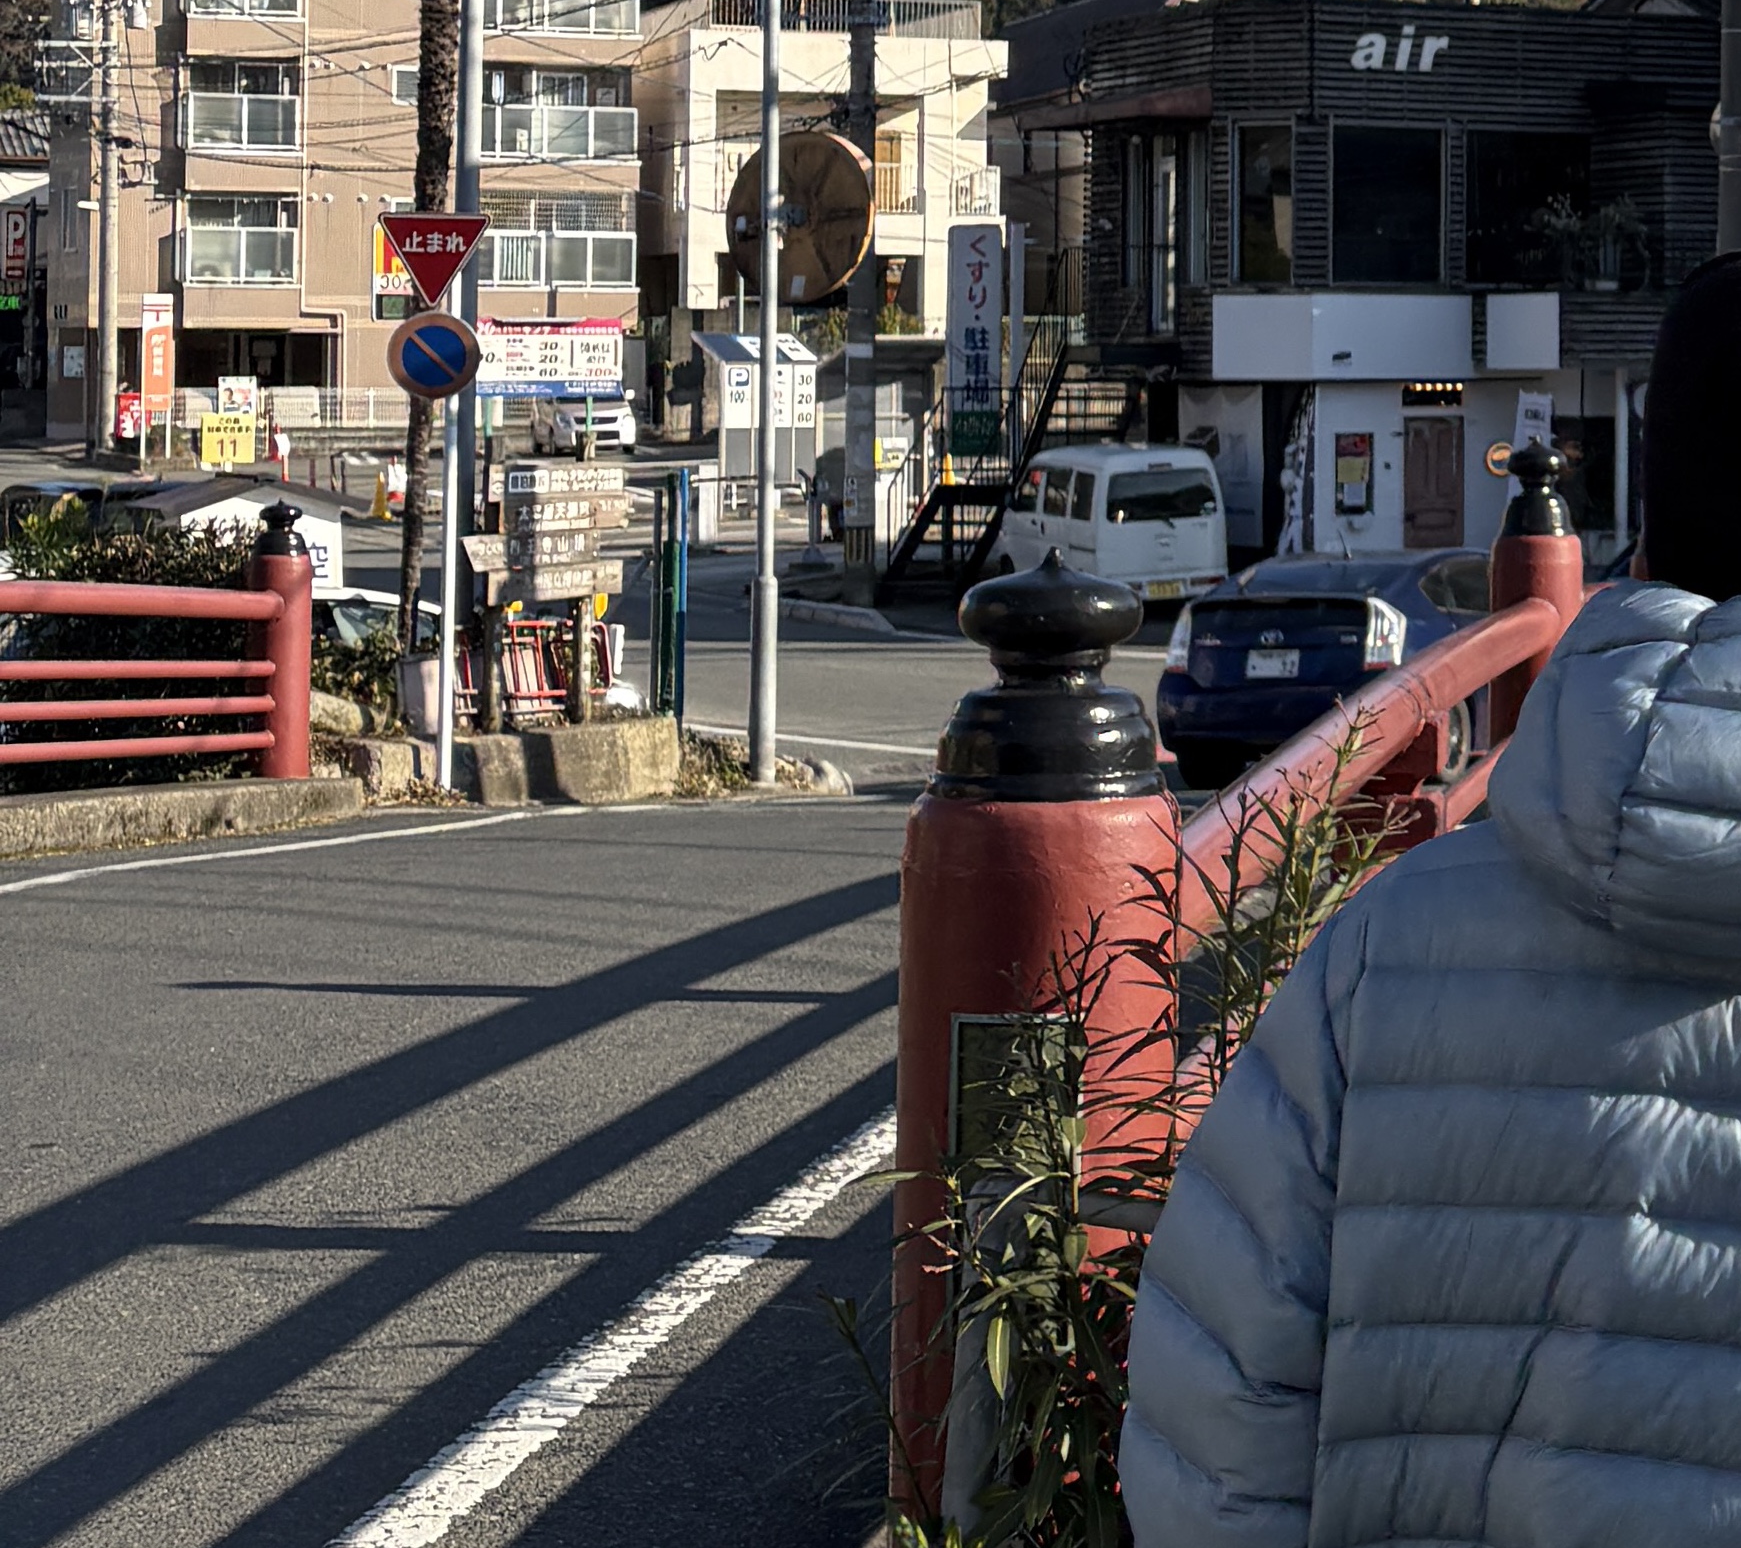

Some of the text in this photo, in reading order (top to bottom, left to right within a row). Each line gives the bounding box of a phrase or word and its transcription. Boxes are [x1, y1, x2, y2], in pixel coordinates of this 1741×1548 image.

[1351, 24, 1450, 72] air
[402, 231, 467, 254] 止まれ
